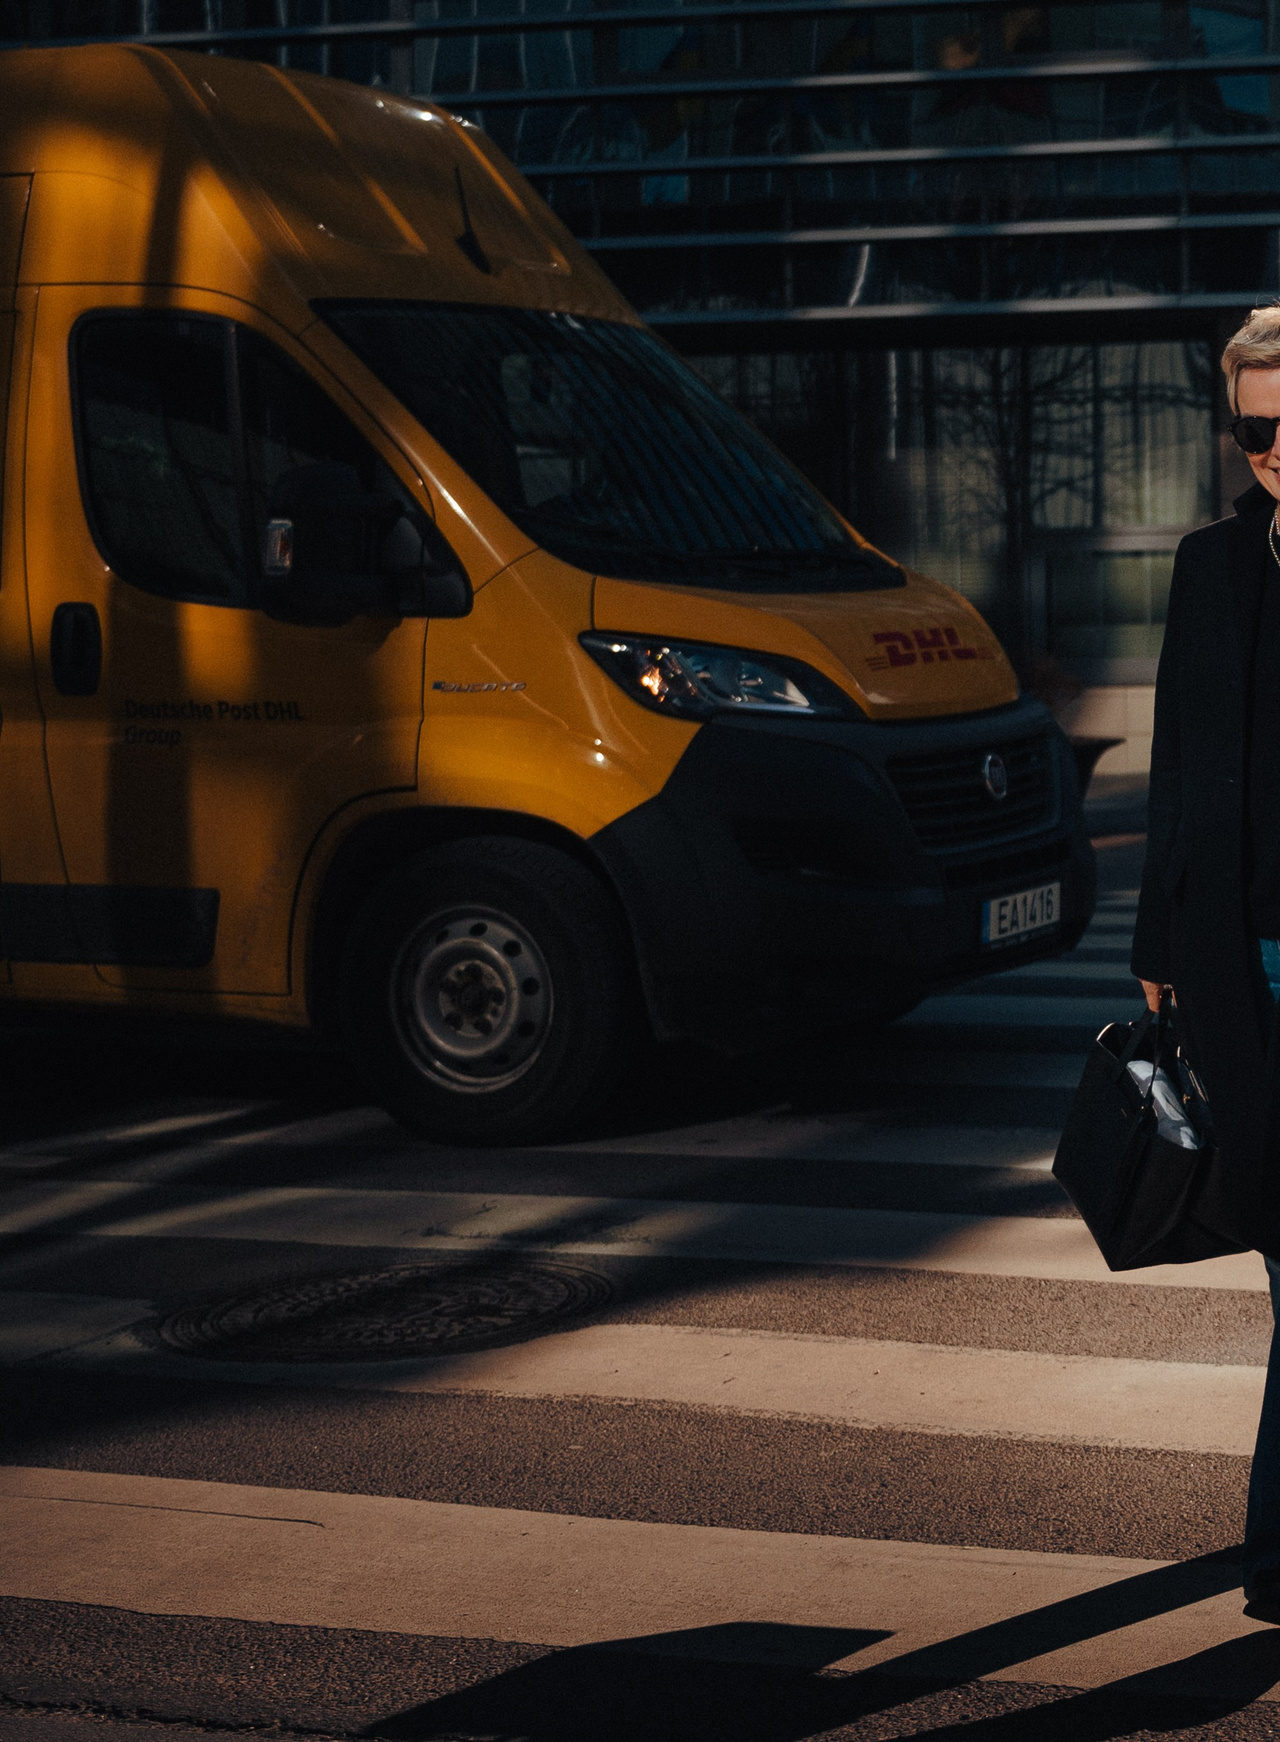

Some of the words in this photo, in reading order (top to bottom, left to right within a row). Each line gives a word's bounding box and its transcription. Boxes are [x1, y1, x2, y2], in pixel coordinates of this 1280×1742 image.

[873, 627, 977, 667] DHL
[441, 681, 527, 693] DUCATO
[124, 698, 213, 720] Deutsche
[217, 700, 261, 720] Post
[264, 701, 305, 721] DHL
[124, 726, 182, 747] Group
[997, 887, 1055, 936] EA1416
